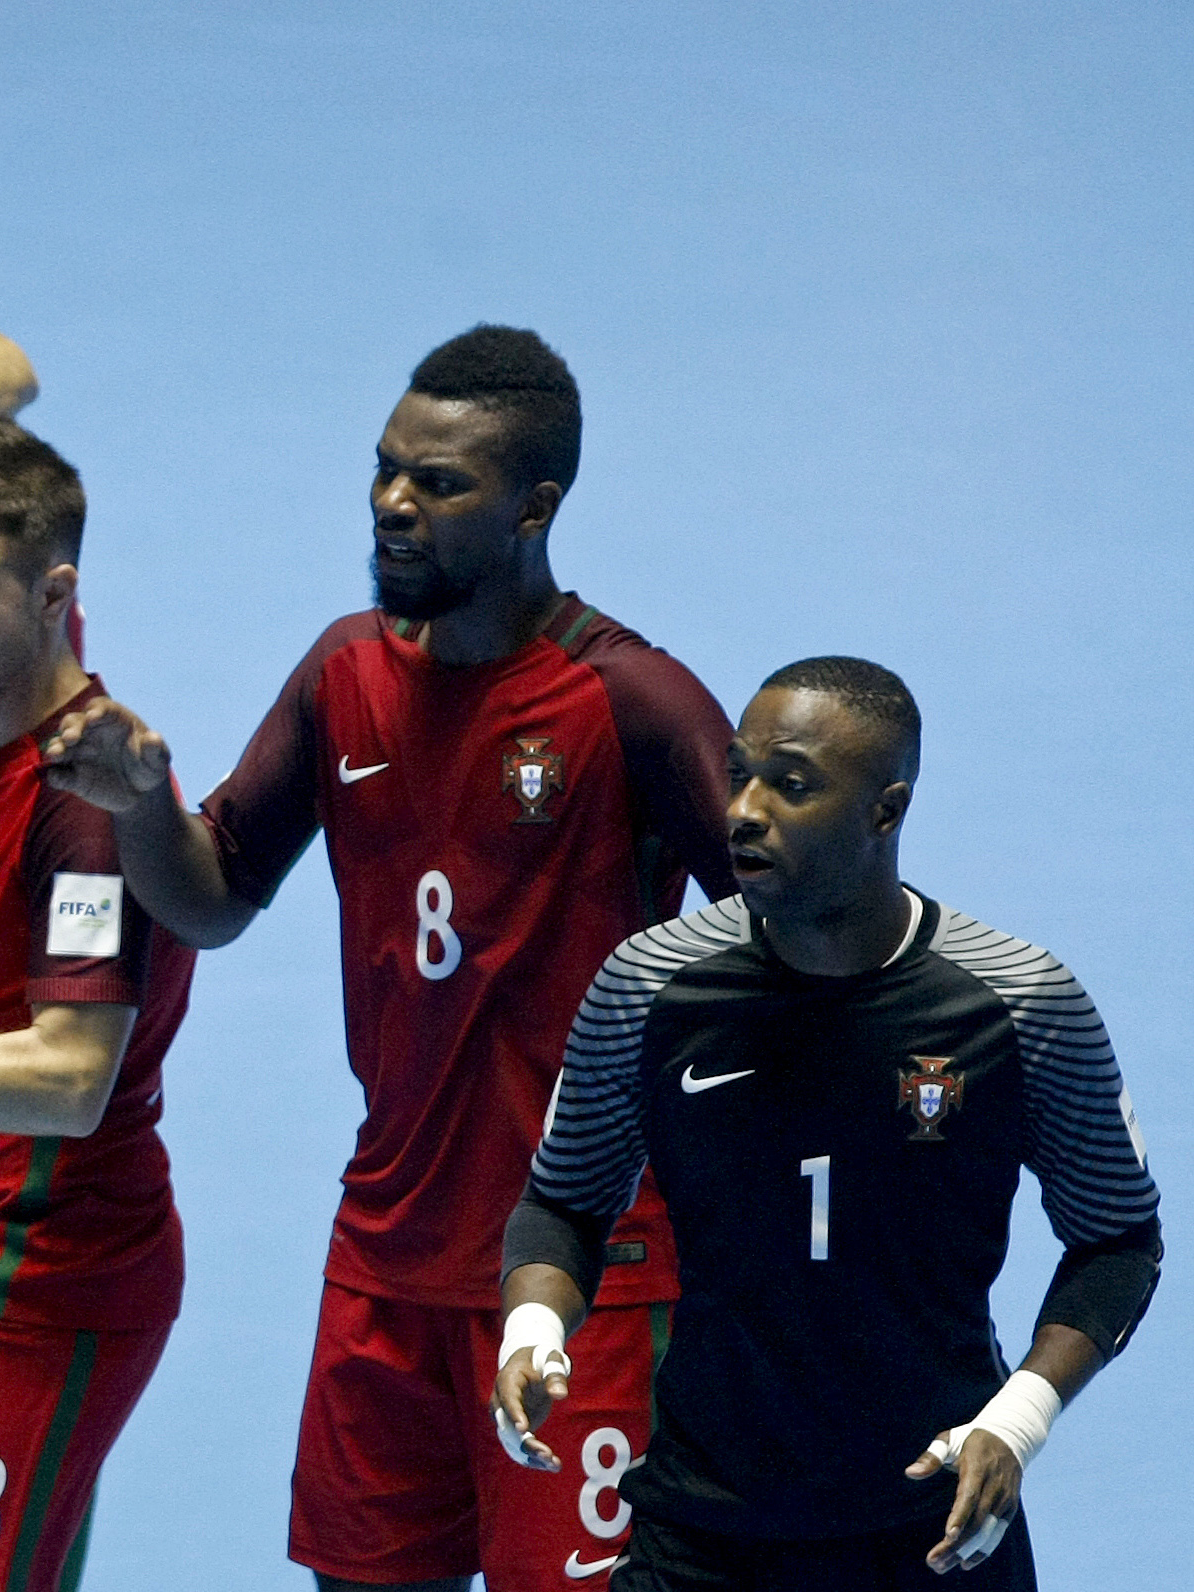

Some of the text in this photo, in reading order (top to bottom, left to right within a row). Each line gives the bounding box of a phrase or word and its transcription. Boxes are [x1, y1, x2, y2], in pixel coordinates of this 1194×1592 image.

[59, 901, 97, 917] FIFA
[416, 869, 463, 981] 8
[800, 1154, 831, 1261] 1
[578, 1427, 633, 1539] 8
